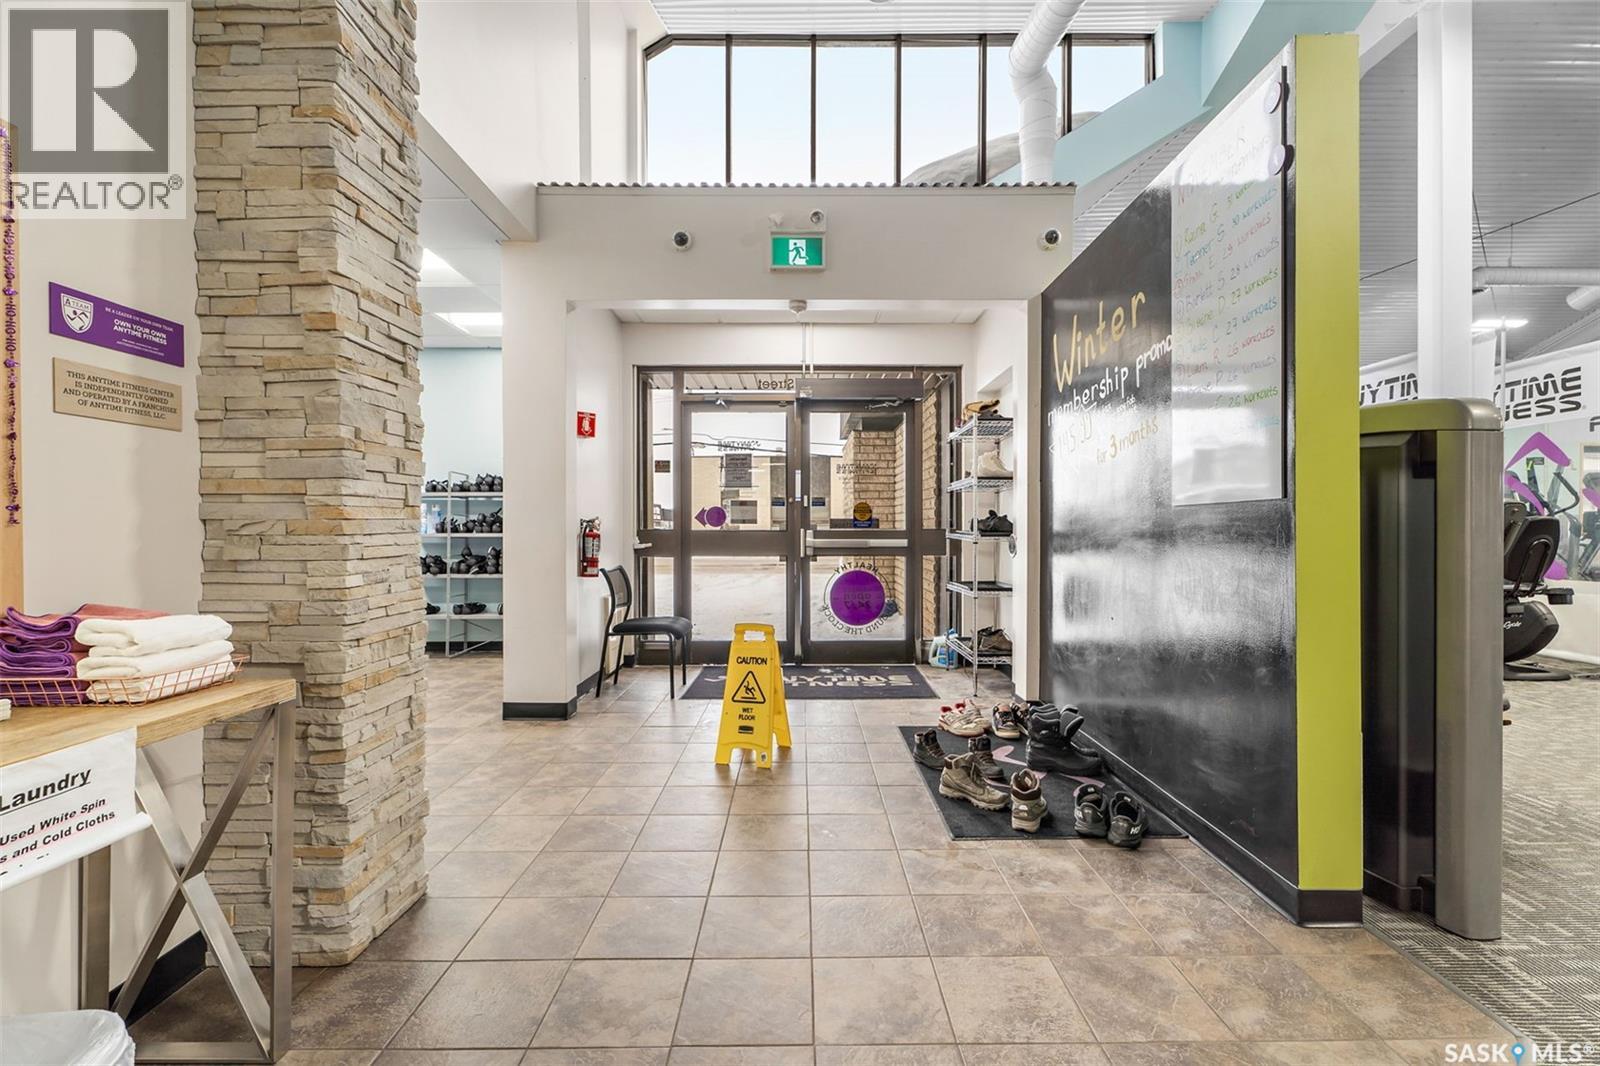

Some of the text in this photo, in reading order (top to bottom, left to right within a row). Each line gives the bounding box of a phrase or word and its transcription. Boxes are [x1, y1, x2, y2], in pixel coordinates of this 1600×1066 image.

[113, 325, 142, 339] ANYTIME
[143, 333, 167, 346] FITNESS
[114, 318, 167, 339] OWN YOUR OWN
[1053, 291, 1146, 393] Winter
[63, 387, 81, 397] AND
[82, 390, 121, 405] OPERATED
[122, 399, 131, 407] BY
[66, 370, 174, 398] THIS ANYTIME FITNESS CENTER
[75, 381, 169, 405] IS INDEPENDENTLY OWNED
[1047, 366, 1129, 427] membership
[77, 398, 88, 407] OF
[89, 400, 123, 413] ANYTIME
[1109, 434, 1117, 459] 3
[1119, 415, 1158, 450] months
[736, 656, 768, 666] CAUTION
[0, 769, 92, 812] Laundry
[0, 798, 106, 846] Used White Spin
[12, 840, 38, 859] and
[42, 827, 72, 846] Cold
[76, 810, 116, 832] Cloths
